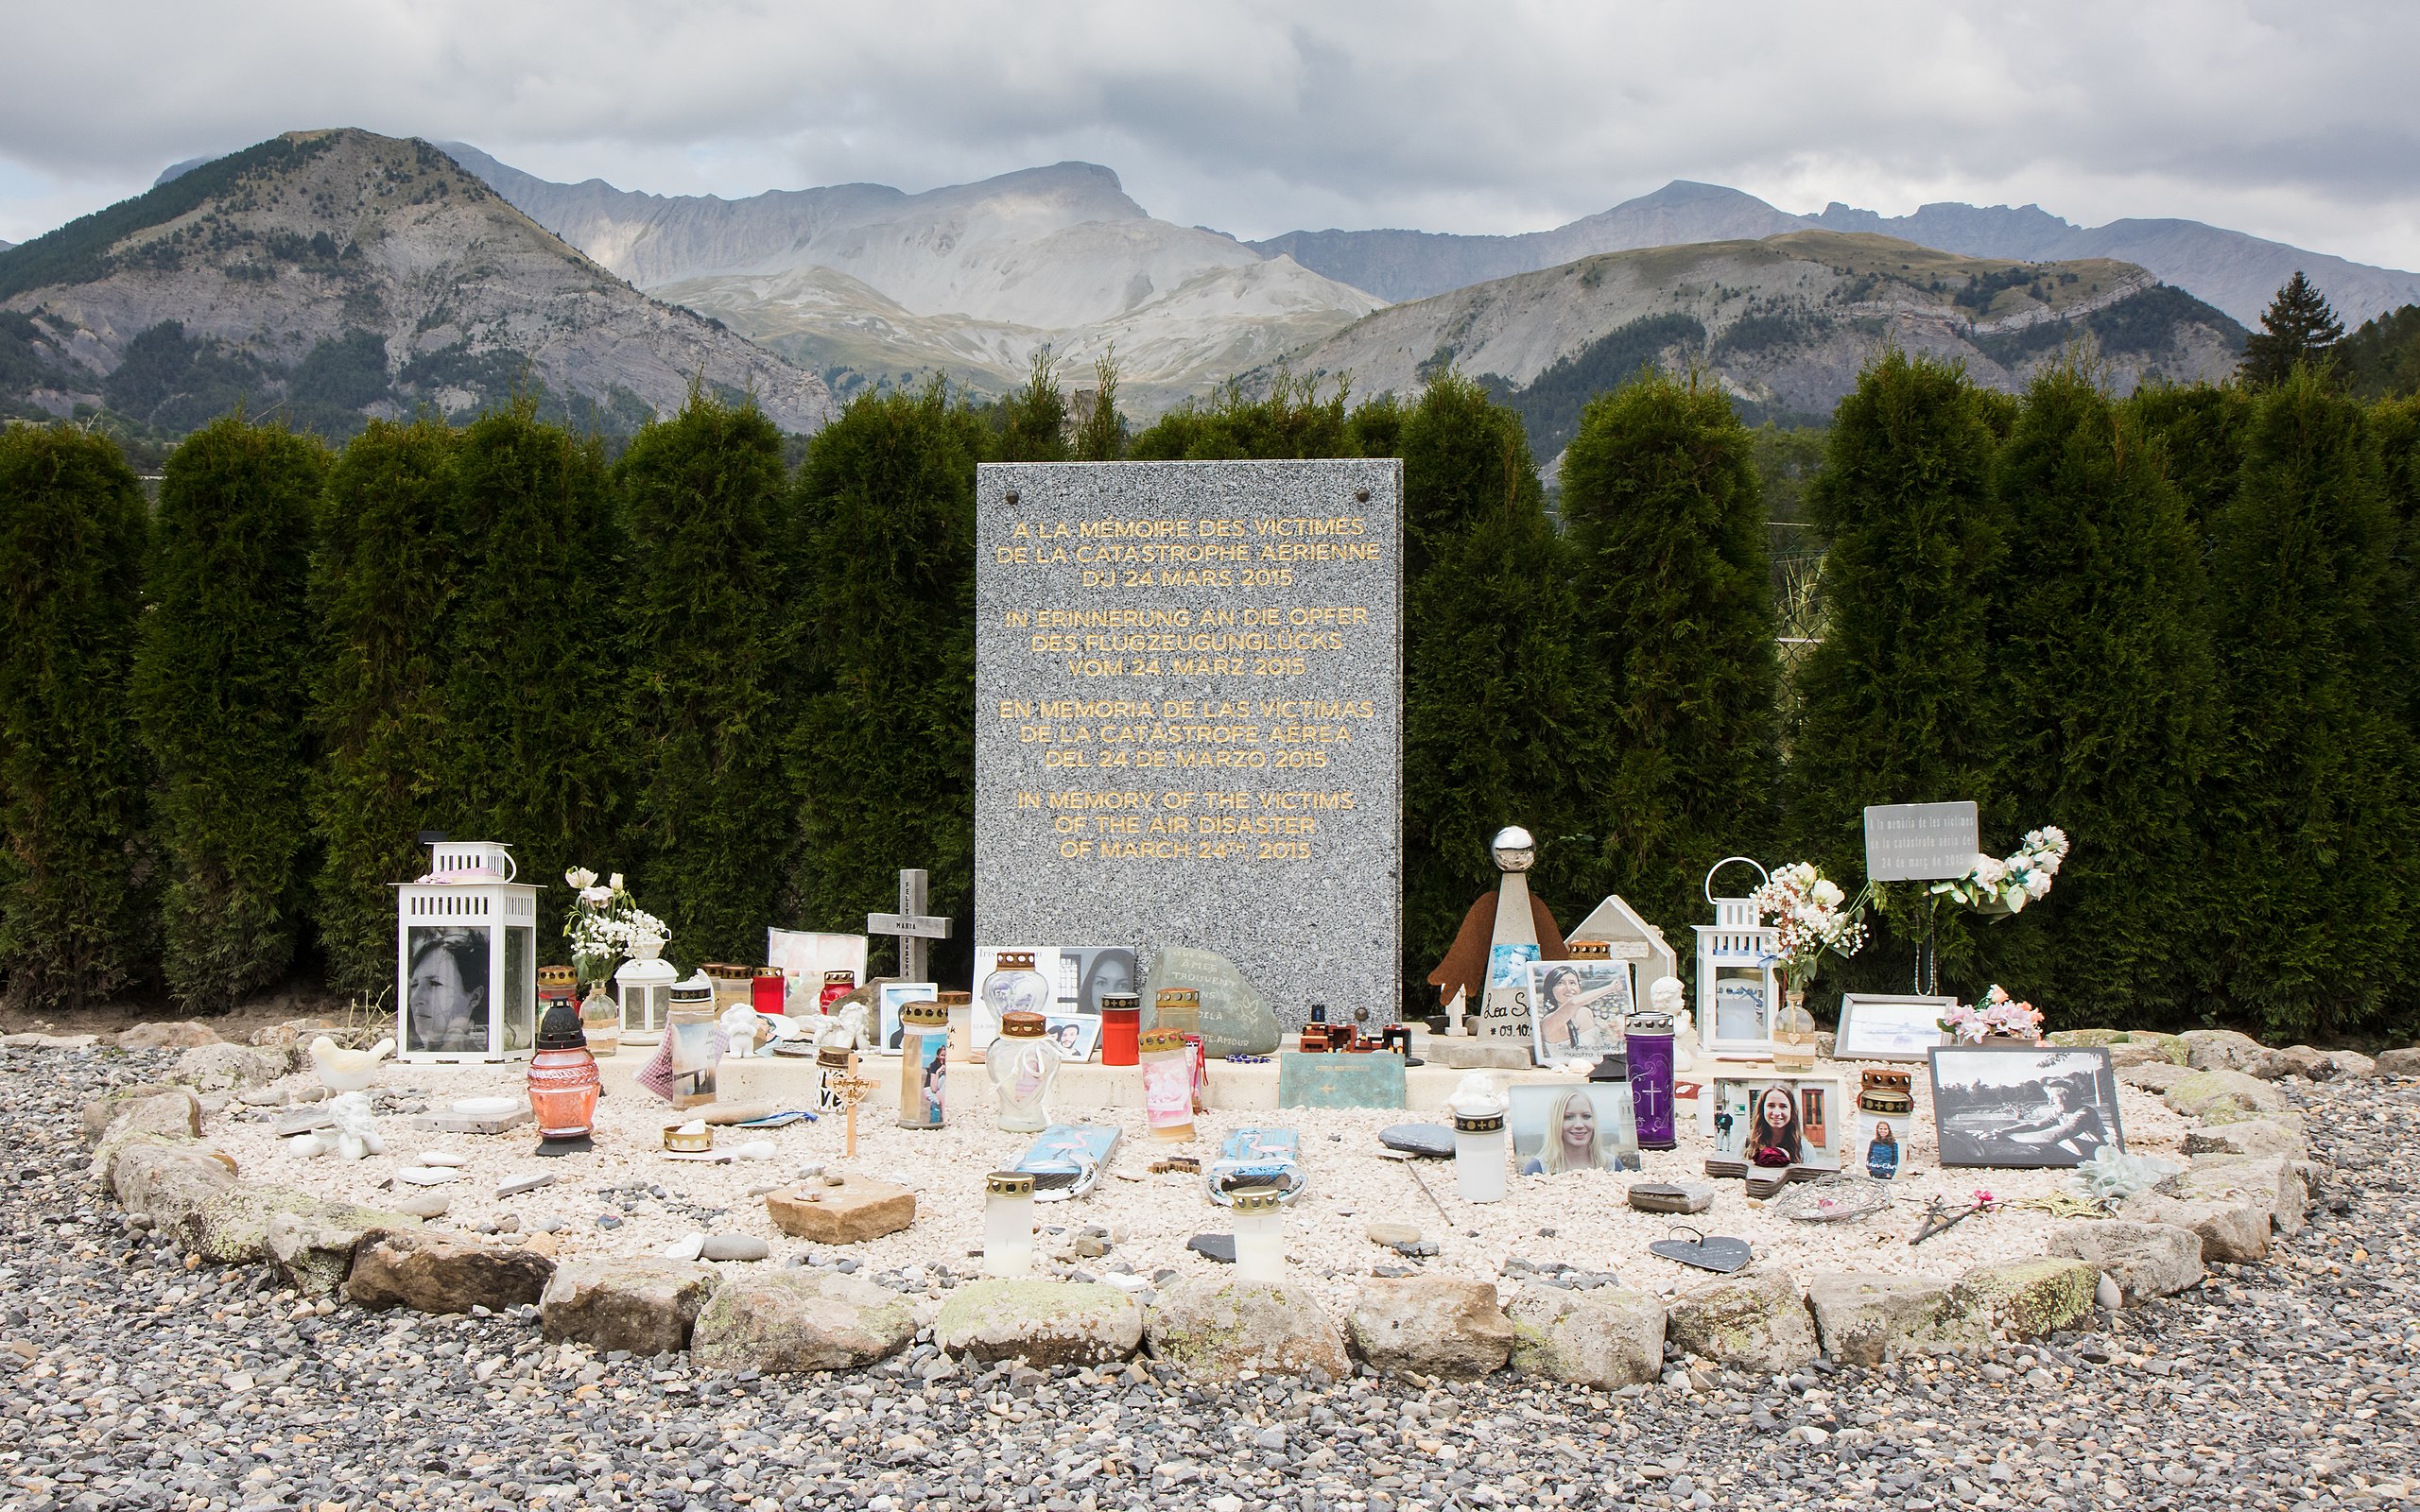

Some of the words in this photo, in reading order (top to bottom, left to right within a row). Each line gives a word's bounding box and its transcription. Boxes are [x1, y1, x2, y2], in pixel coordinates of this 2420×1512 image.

[1013, 522, 1031, 539] A
[1040, 522, 1071, 539] LA
[1080, 516, 1190, 539] MÉMOIRE
[1200, 519, 1246, 538] DES
[1254, 517, 1365, 537] VICTIMES
[997, 546, 1028, 564] DE
[1037, 546, 1068, 563] LA
[1077, 544, 1251, 563] CATASTROPHE
[1260, 540, 1381, 561] AÉRIENNE
[1083, 571, 1116, 588] DU
[1126, 571, 1153, 588] 24
[1163, 570, 1232, 587] MARS
[1240, 569, 1295, 587] 2015
[1006, 611, 1028, 627] IN
[1038, 610, 1190, 628] ERINNERUNG
[1200, 610, 1235, 626] AN
[1245, 609, 1280, 626] DIE
[1289, 608, 1369, 626] OPFER
[1032, 636, 1078, 653] DES
[1086, 629, 1343, 652] FLUGZEUGUNGLÜCKS
[1069, 661, 1123, 678] VOM
[1254, 659, 1306, 677] 2015
[1000, 701, 1031, 719] EN
[1041, 700, 1155, 718] MEMORIA
[1164, 701, 1195, 718] DE
[1203, 700, 1251, 718] LAS
[1260, 696, 1374, 718] VÍCTIMAS
[1021, 727, 1052, 743] DE
[1061, 727, 1091, 743] LA
[1100, 721, 1259, 744] CATÁSTROFE
[1270, 721, 1352, 743] AÉREA
[1046, 752, 1091, 768] DEL
[1101, 751, 1129, 768] 24
[1137, 751, 1167, 768] DE
[1176, 750, 1267, 768] MARZO
[1276, 750, 1327, 768] 2015
[1018, 793, 1040, 809] IN
[1049, 793, 1154, 810] MEMORY
[1164, 792, 1196, 810] OF
[1204, 793, 1250, 809] THE
[1259, 793, 1355, 810] VICTIMS
[1055, 817, 1087, 834] OF
[1096, 817, 1140, 834] THE
[1150, 817, 1189, 834] AIR
[1200, 817, 1315, 834] DISASTER
[1876, 818, 1884, 830] la
[1919, 816, 1927, 828] de
[1929, 816, 1940, 828] les
[1061, 841, 1092, 859] OF
[1100, 841, 1190, 859] MARCH
[1260, 842, 1312, 860] 2015
[1871, 838, 1879, 850] de
[1883, 837, 1890, 849] la
[1962, 833, 1975, 846] del
[1882, 856, 1892, 868] 24
[1895, 856, 1905, 868] de
[1932, 855, 1942, 868] de
[1945, 854, 1964, 867] 2015
[1172, 971, 1236, 988] TROUVENT
